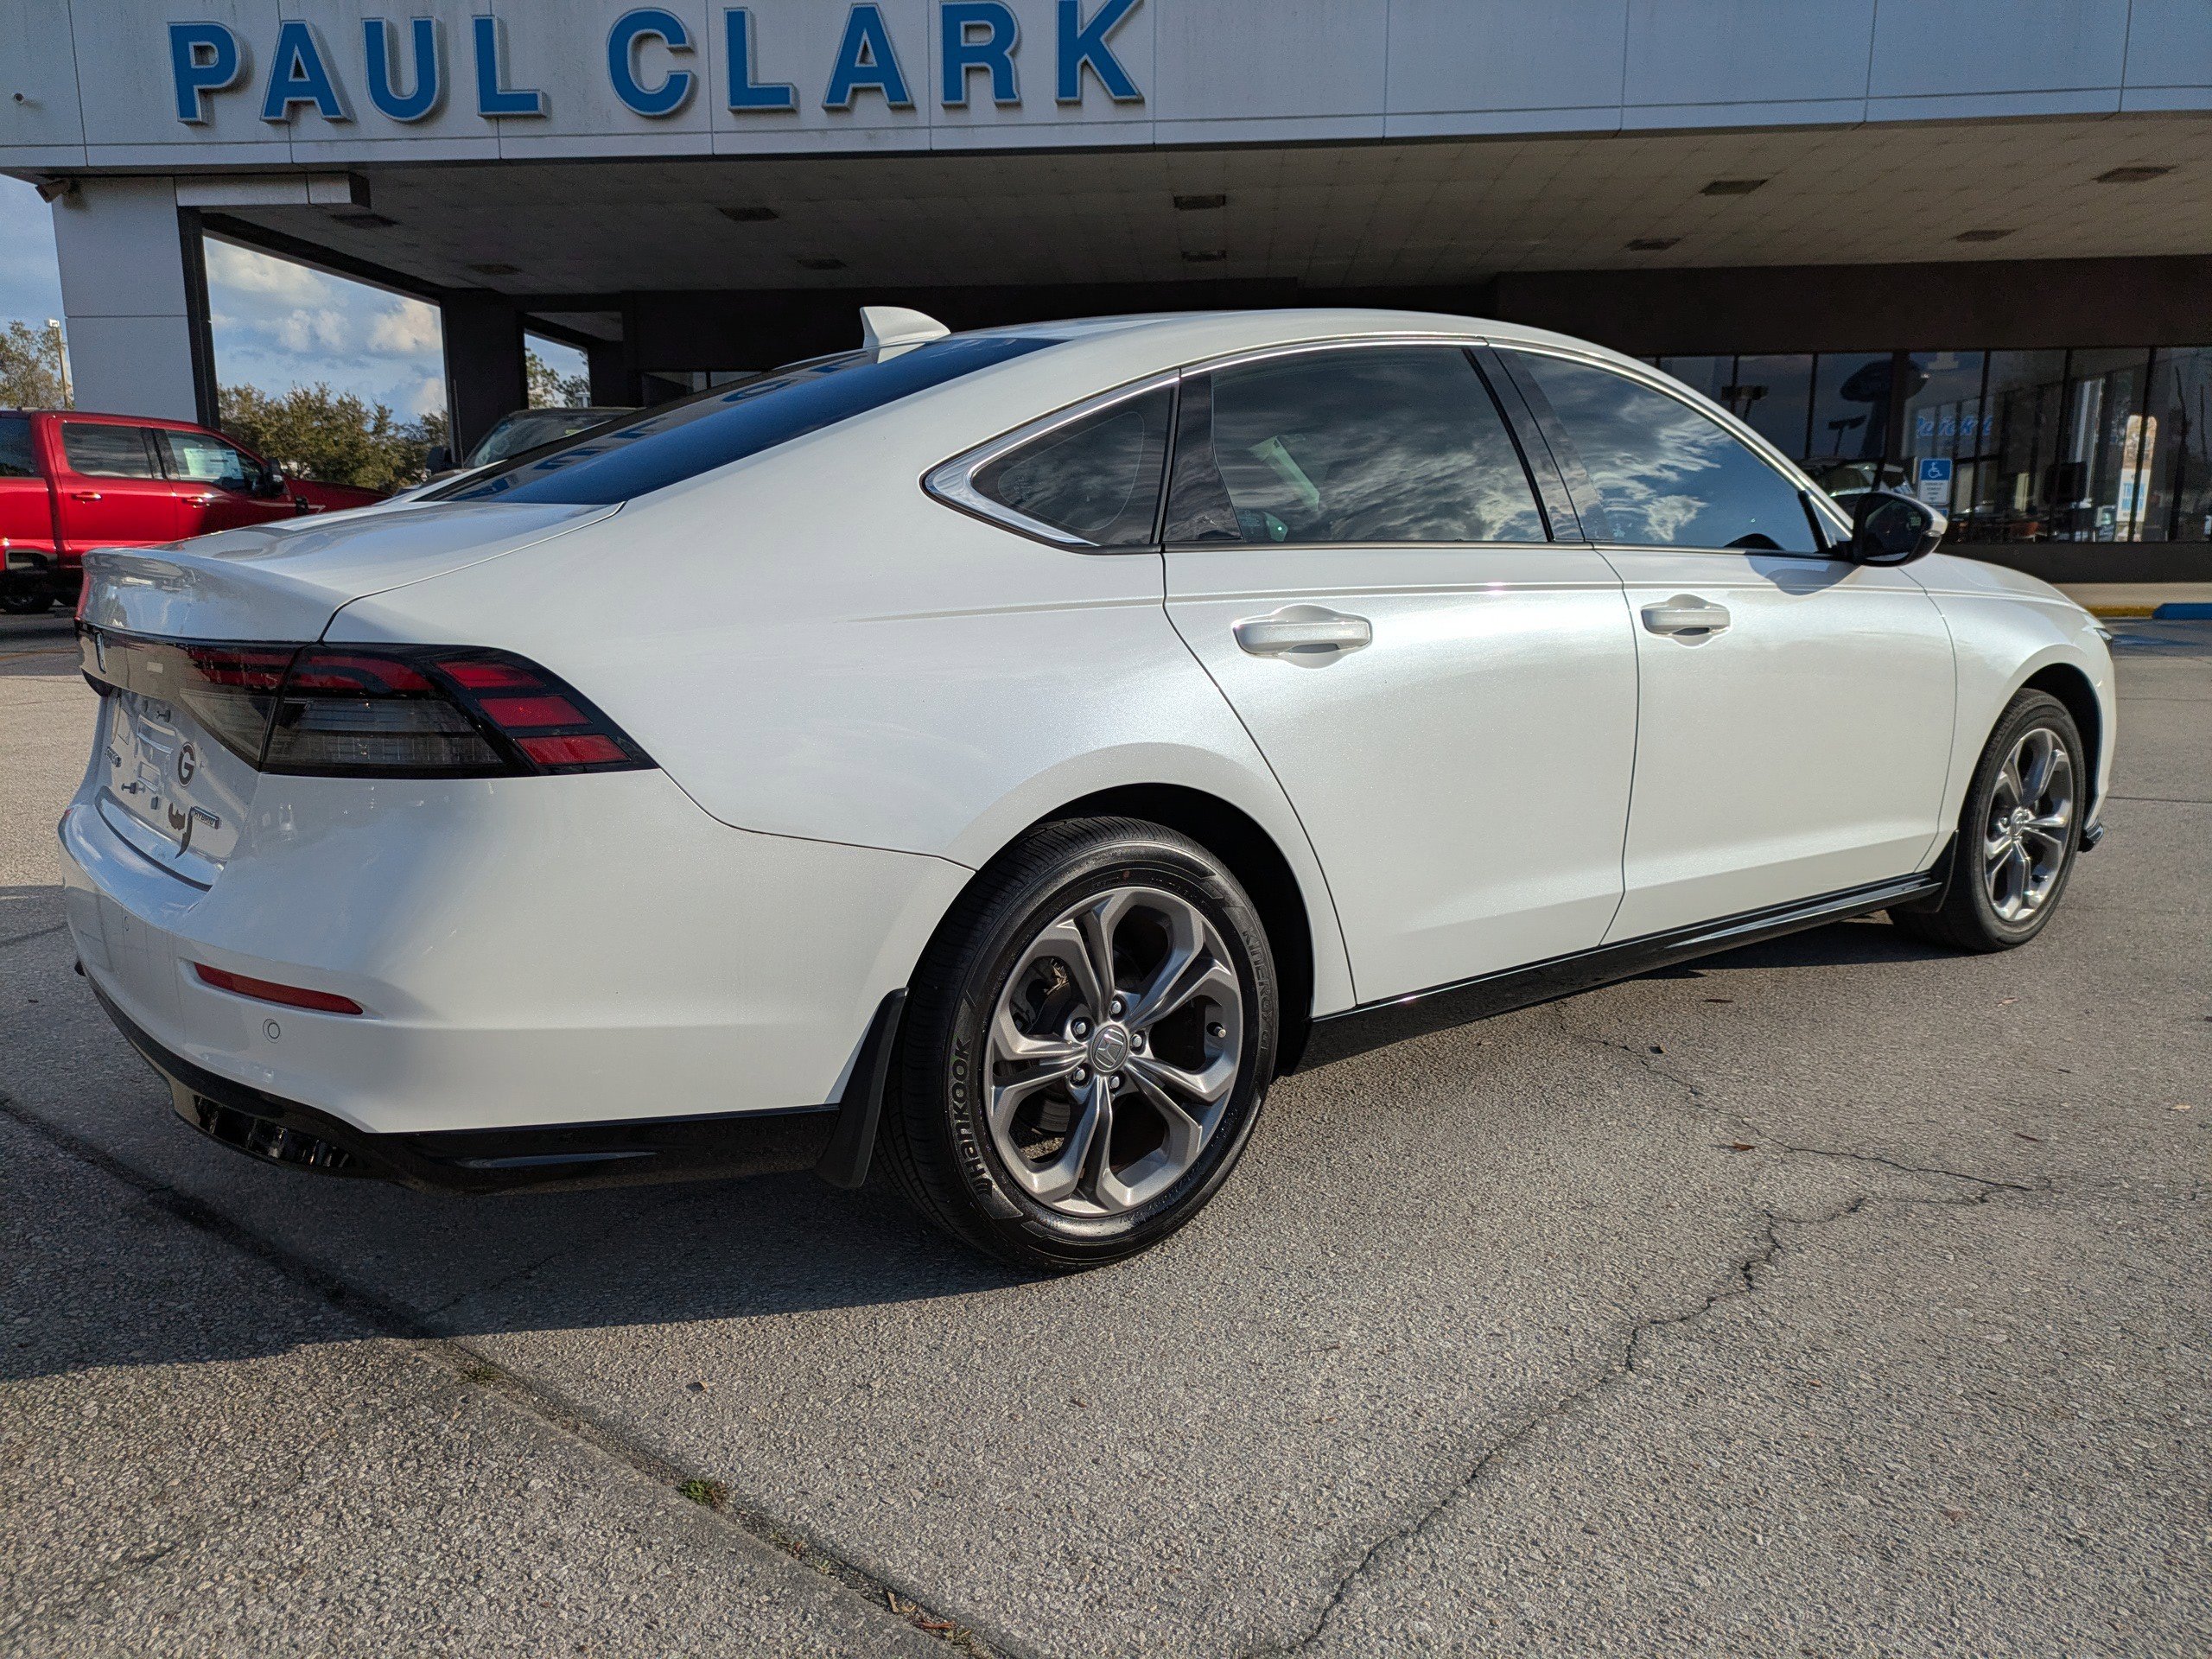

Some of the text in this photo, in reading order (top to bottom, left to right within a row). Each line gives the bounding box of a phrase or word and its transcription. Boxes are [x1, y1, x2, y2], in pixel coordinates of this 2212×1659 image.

[169, 0, 1143, 124] PAUL CLARK
[178, 742, 195, 787] G
